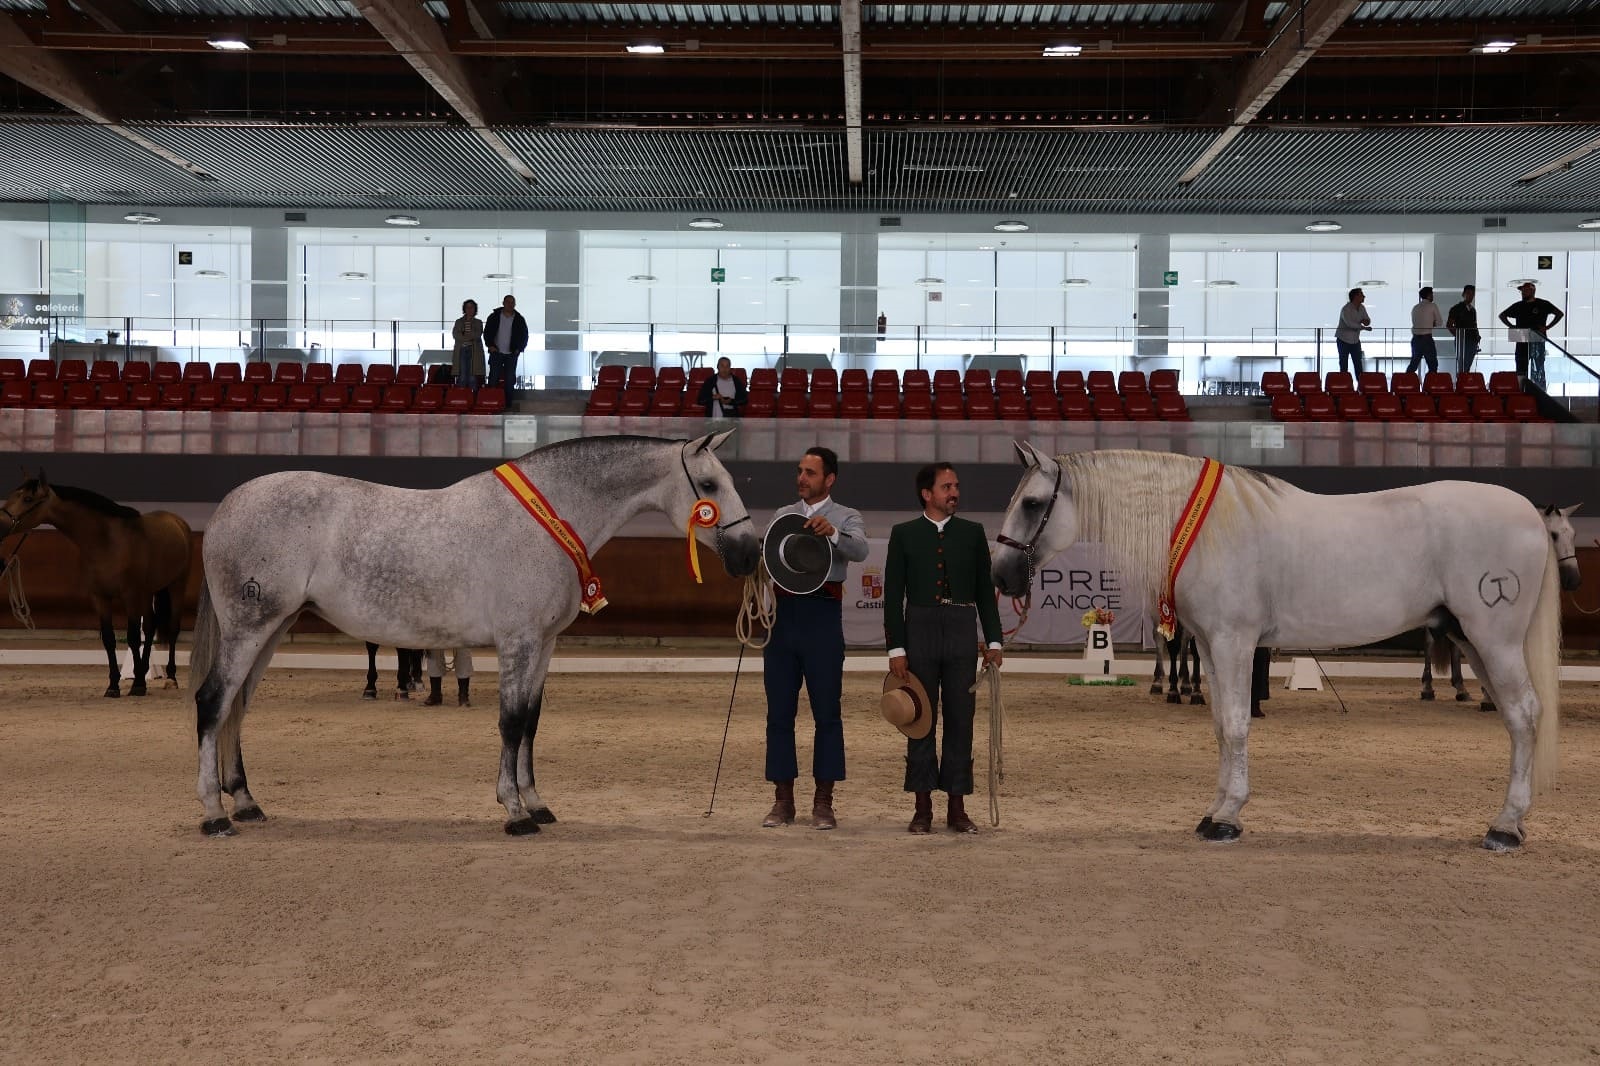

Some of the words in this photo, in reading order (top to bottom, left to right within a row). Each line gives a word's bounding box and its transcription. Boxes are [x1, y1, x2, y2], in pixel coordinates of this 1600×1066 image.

[1041, 570, 1121, 591] PRE
[1041, 595, 1121, 610] ANCCE
[1093, 631, 1109, 649] B
